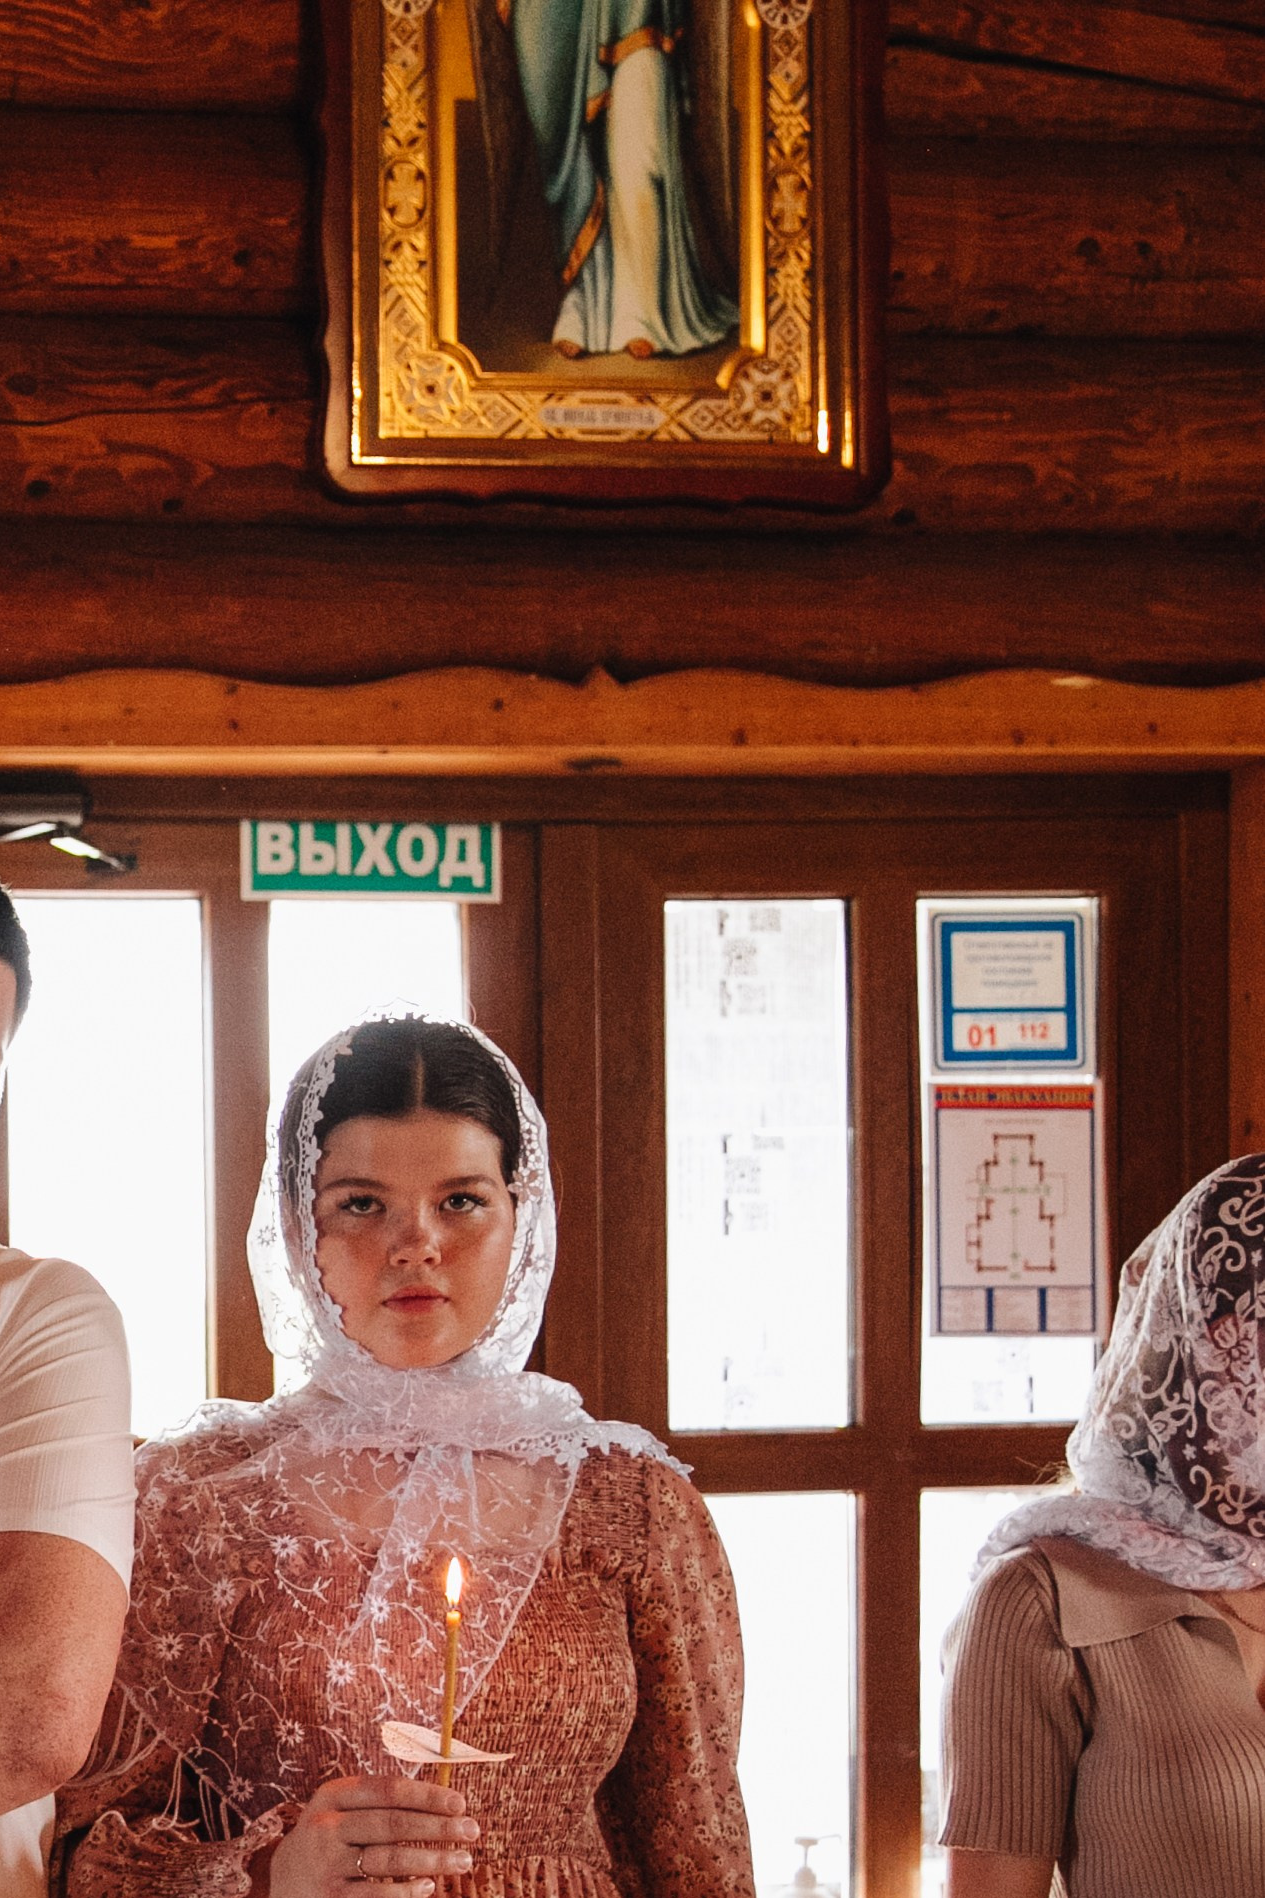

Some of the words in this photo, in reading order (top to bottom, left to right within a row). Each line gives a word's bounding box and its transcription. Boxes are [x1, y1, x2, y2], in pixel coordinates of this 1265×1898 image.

[255, 821, 485, 888] ВЫХОД
[968, 1024, 998, 1047] 01
[1019, 1023, 1050, 1039] 112
